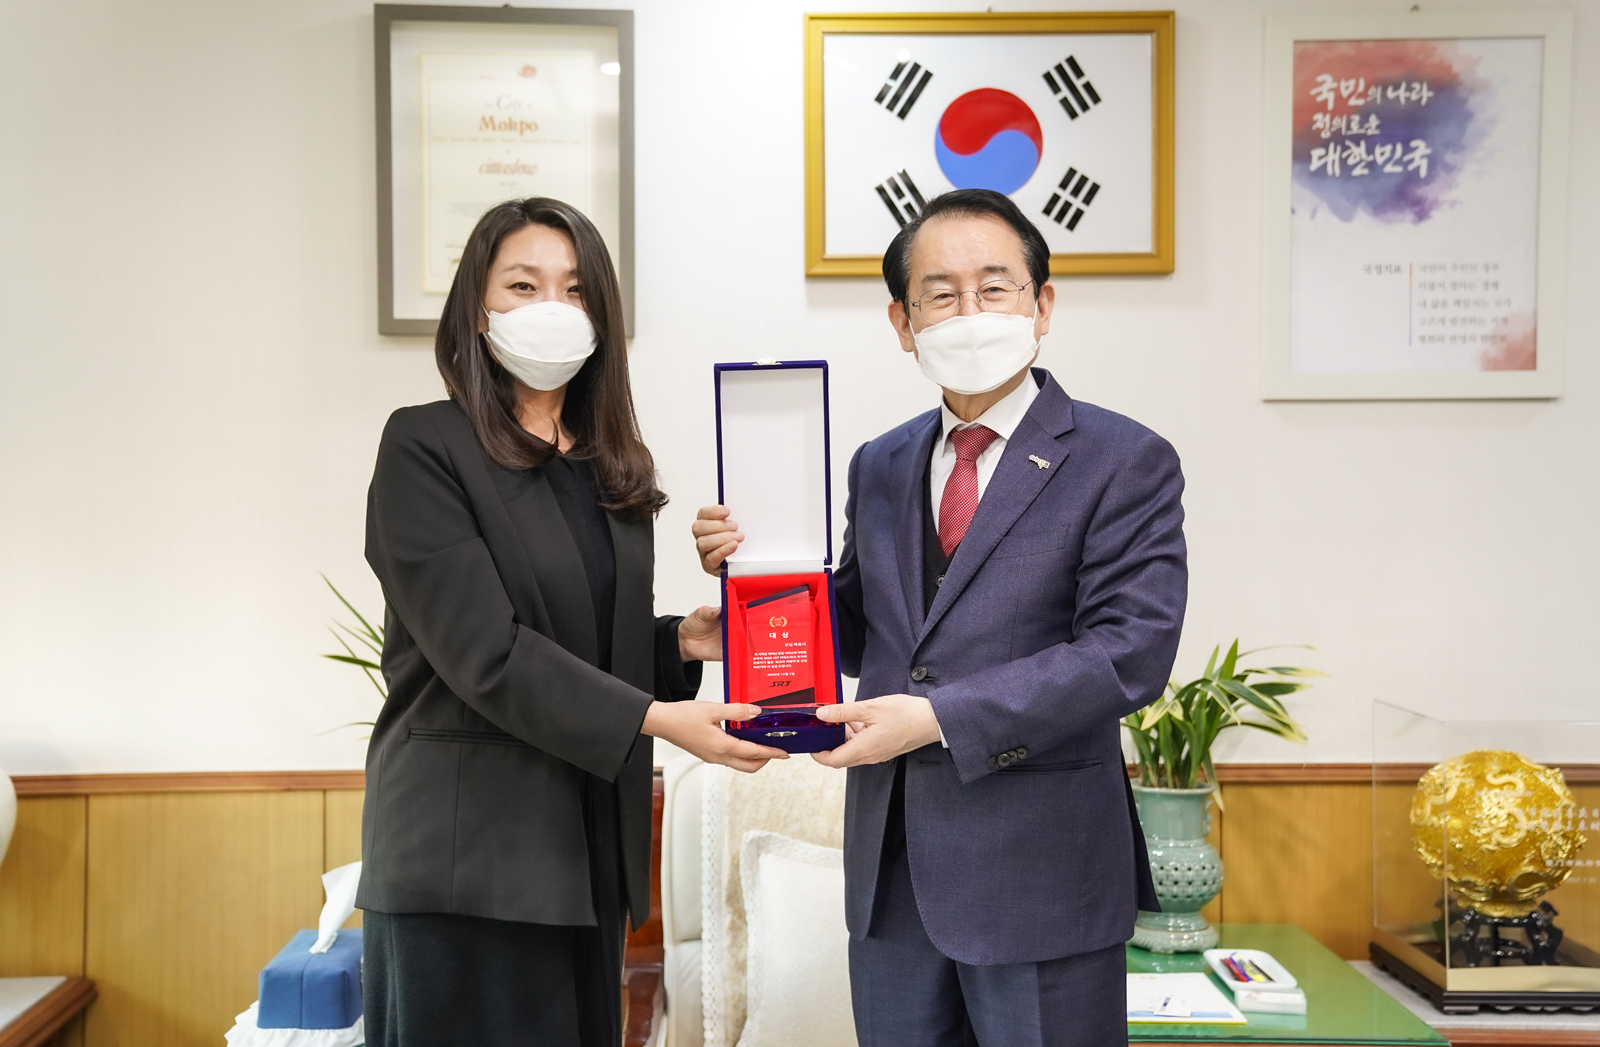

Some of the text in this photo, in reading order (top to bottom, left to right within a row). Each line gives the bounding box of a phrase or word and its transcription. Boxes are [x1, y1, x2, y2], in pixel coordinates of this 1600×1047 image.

[1309, 73, 1434, 111] 국민의 나라
[478, 115, 539, 136] Mokpo
[1311, 112, 1381, 139] 정의로운
[478, 158, 539, 175] cittaslow
[1309, 139, 1432, 179] 대한민국
